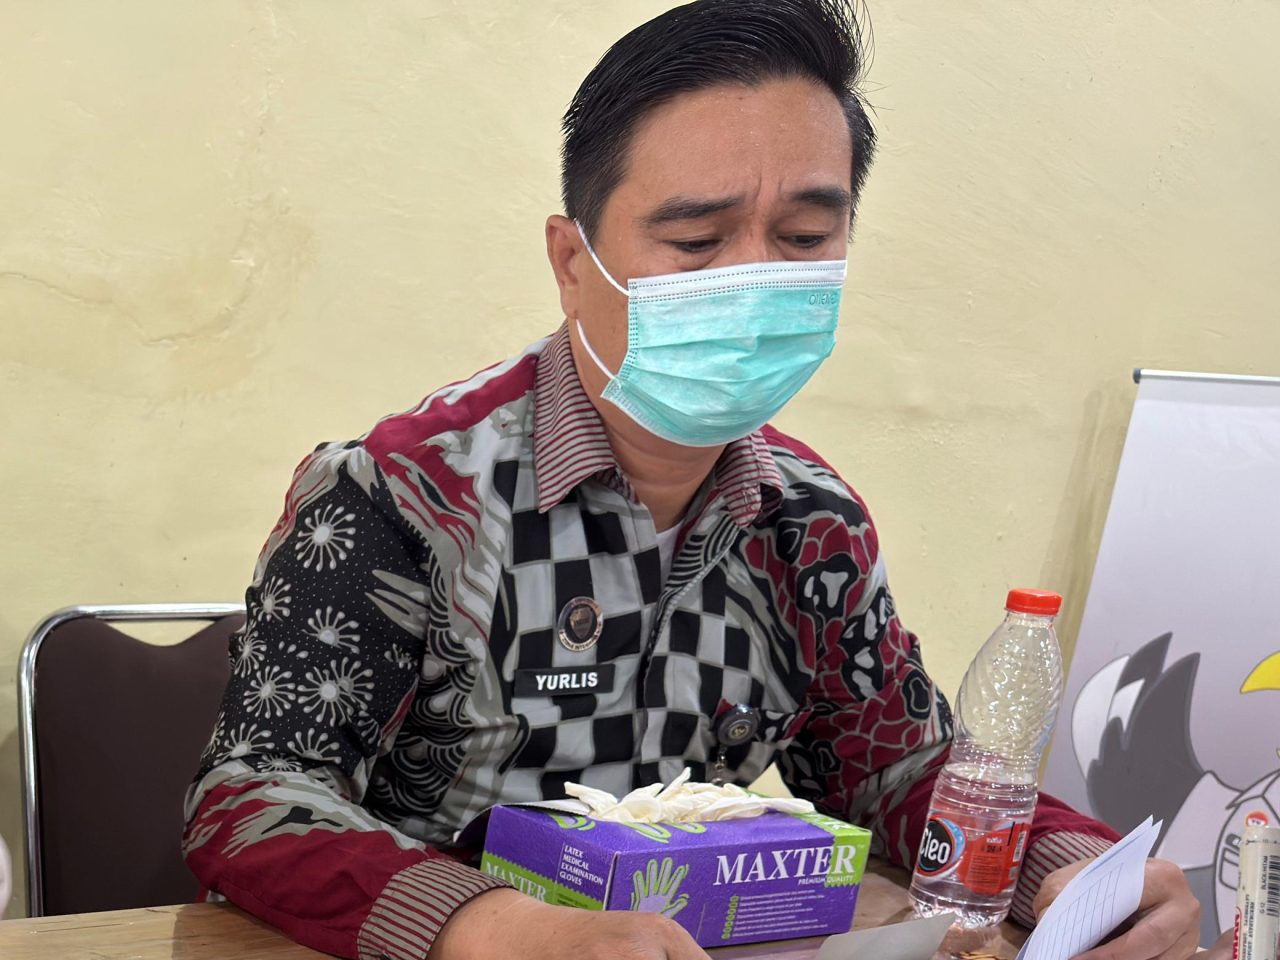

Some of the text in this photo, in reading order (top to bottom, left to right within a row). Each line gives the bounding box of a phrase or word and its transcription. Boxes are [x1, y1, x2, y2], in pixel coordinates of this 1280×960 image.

[535, 672, 598, 691] YURLIS
[564, 845, 584, 858] LATEX
[920, 827, 951, 864] Cleo
[563, 854, 589, 870] MEDICAL
[712, 844, 857, 886] MAXTER
[485, 861, 546, 902] MAXTER
[560, 871, 582, 886] GLOVES
[561, 862, 604, 886] EXAMINATION
